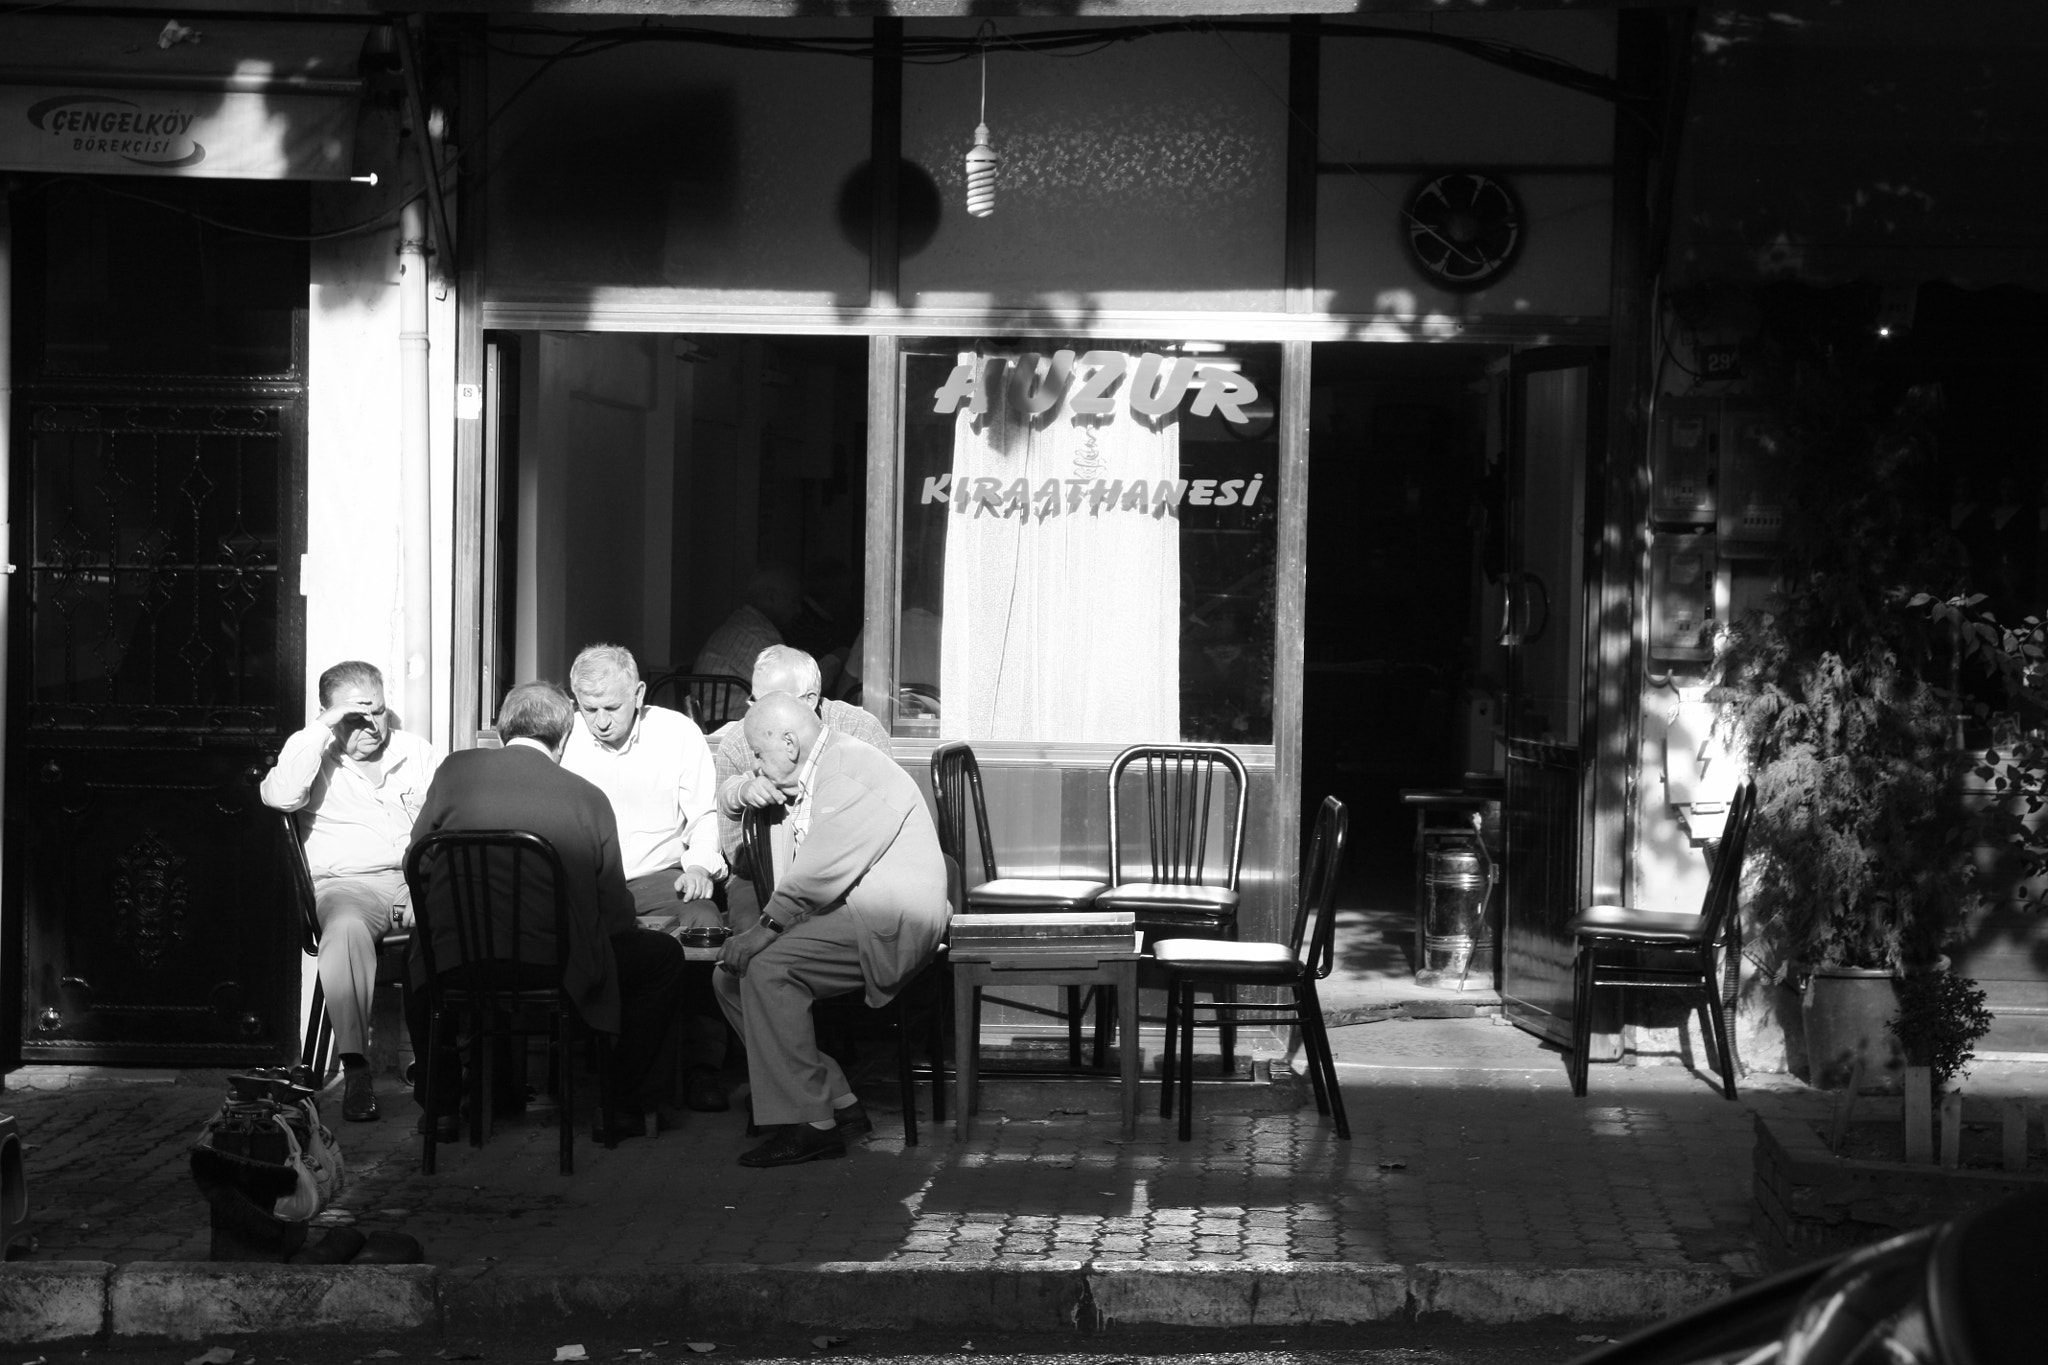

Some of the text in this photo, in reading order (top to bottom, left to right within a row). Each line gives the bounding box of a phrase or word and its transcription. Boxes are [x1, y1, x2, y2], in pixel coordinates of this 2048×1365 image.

[52, 109, 195, 136] ÇENGELKÖY
[73, 136, 170, 156] BÖREKÇİSİ
[933, 349, 1259, 424] HUZUR
[921, 473, 1263, 507] KIRAATHANESİ
